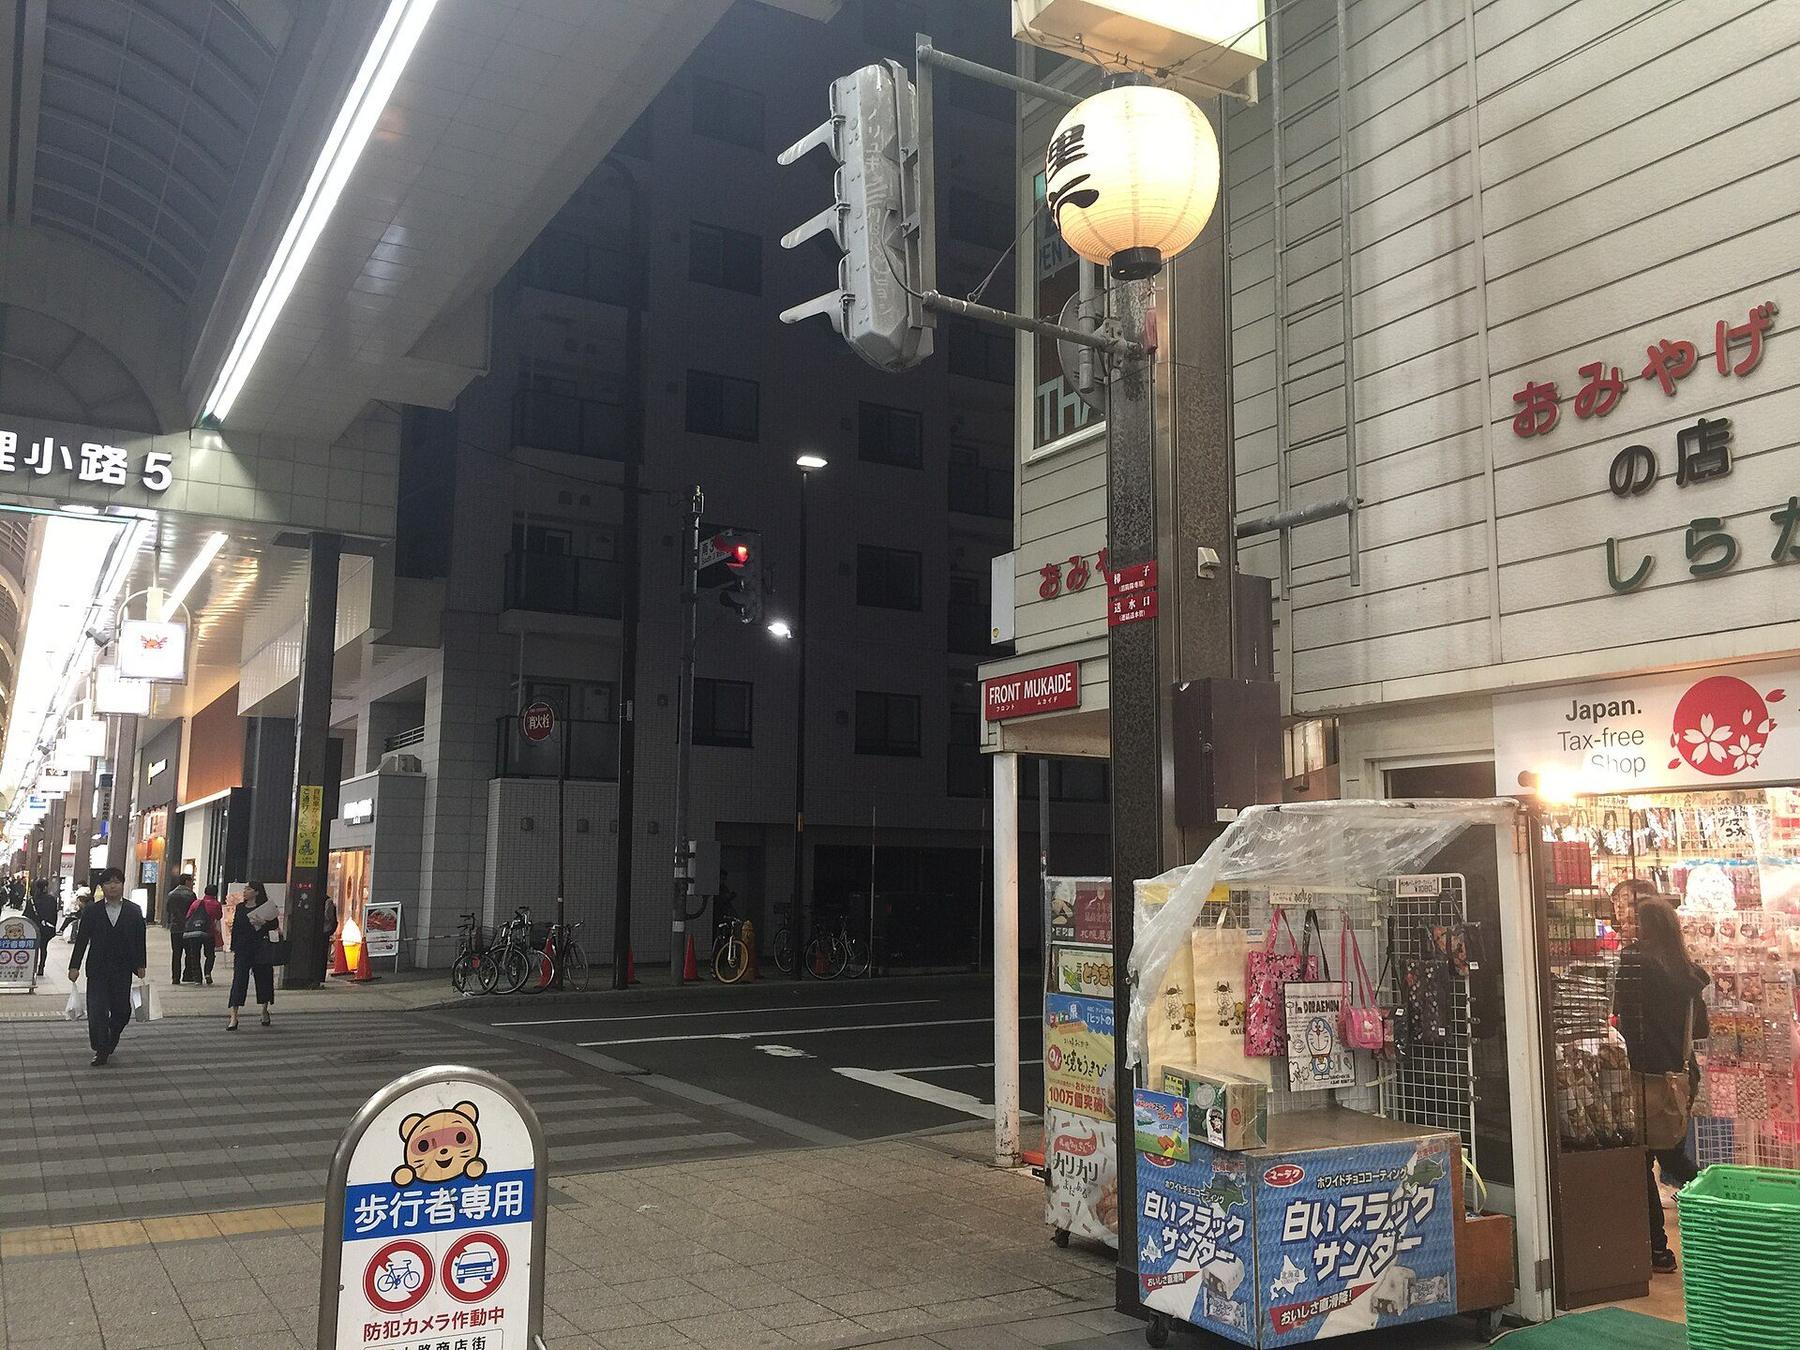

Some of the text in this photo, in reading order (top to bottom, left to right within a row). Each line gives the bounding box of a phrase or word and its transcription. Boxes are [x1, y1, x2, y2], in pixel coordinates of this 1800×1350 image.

[1512, 301, 1779, 438] おみやげ
[142, 452, 173, 491] 5
[1609, 417, 1734, 497] の店
[1113, 596, 1151, 614] 送水口
[989, 672, 1072, 705] FRONT MUKAIDE
[526, 713, 551, 730] 消火栓
[1565, 699, 1643, 724] Japan.
[1557, 726, 1645, 752] Tax-free
[1590, 754, 1646, 777] Shop
[1075, 1082, 1106, 1097] おかげさまで
[1053, 1153, 1098, 1184] カリカリ
[1270, 1167, 1299, 1182] ユーラク
[1317, 1167, 1407, 1189] ホワイトチョココーティング
[354, 1180, 523, 1233] 歩行者専用
[1164, 1180, 1224, 1204] ホワイトチョココーティング
[1143, 1190, 1245, 1242] 白いブラック
[1282, 1186, 1436, 1242] 白いブラック
[1162, 1226, 1236, 1268] サンダー
[1313, 1232, 1423, 1282] サンダー
[1279, 1289, 1353, 1326] おいしさ直滑降!
[363, 1306, 505, 1343] 防犯カメラ作動中
